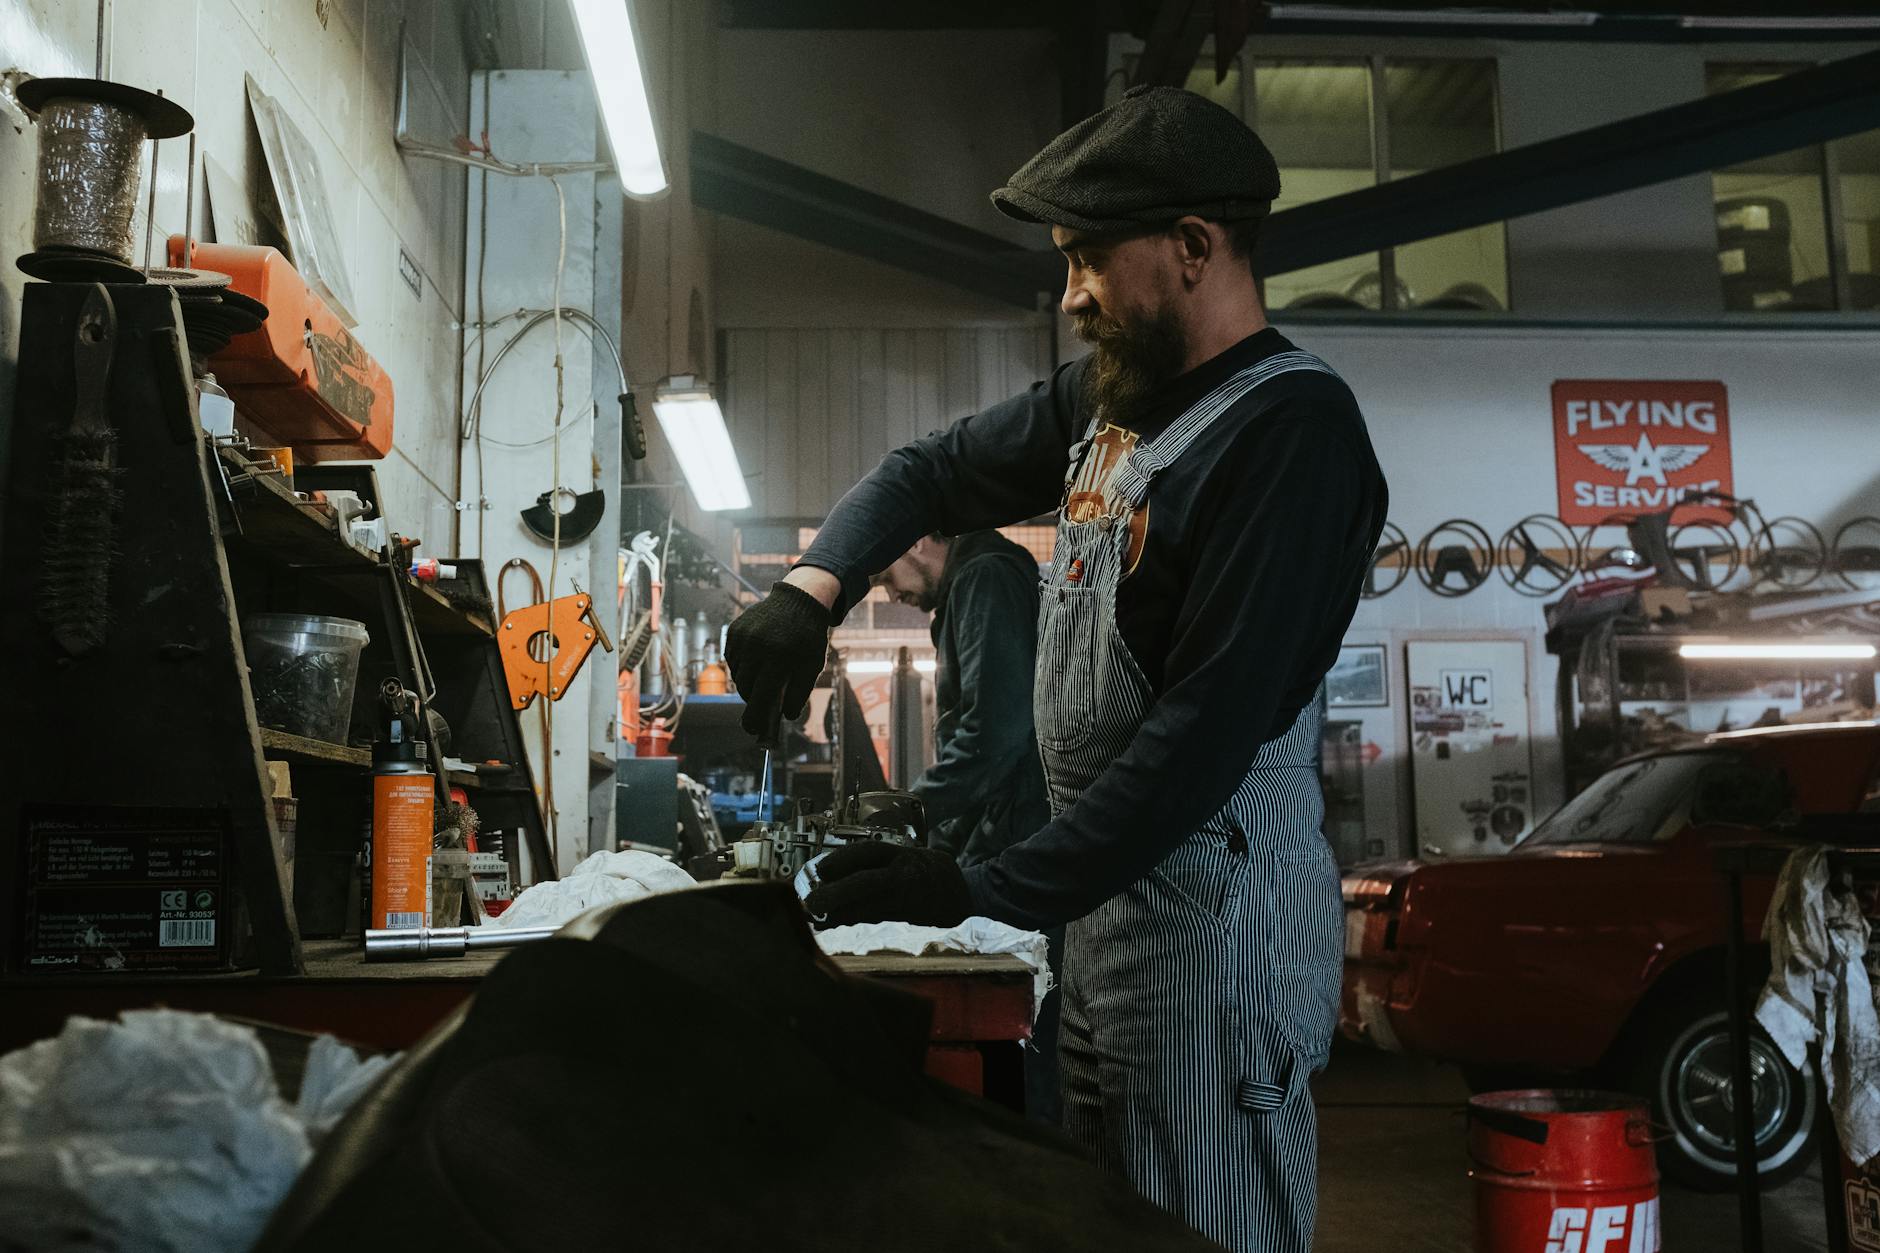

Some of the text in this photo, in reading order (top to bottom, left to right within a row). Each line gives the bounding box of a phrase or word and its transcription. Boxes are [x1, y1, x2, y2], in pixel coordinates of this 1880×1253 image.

[1566, 400, 1718, 437] FLYING
[1446, 676, 1487, 706] WC
[160, 911, 187, 919] Art.-Nr.
